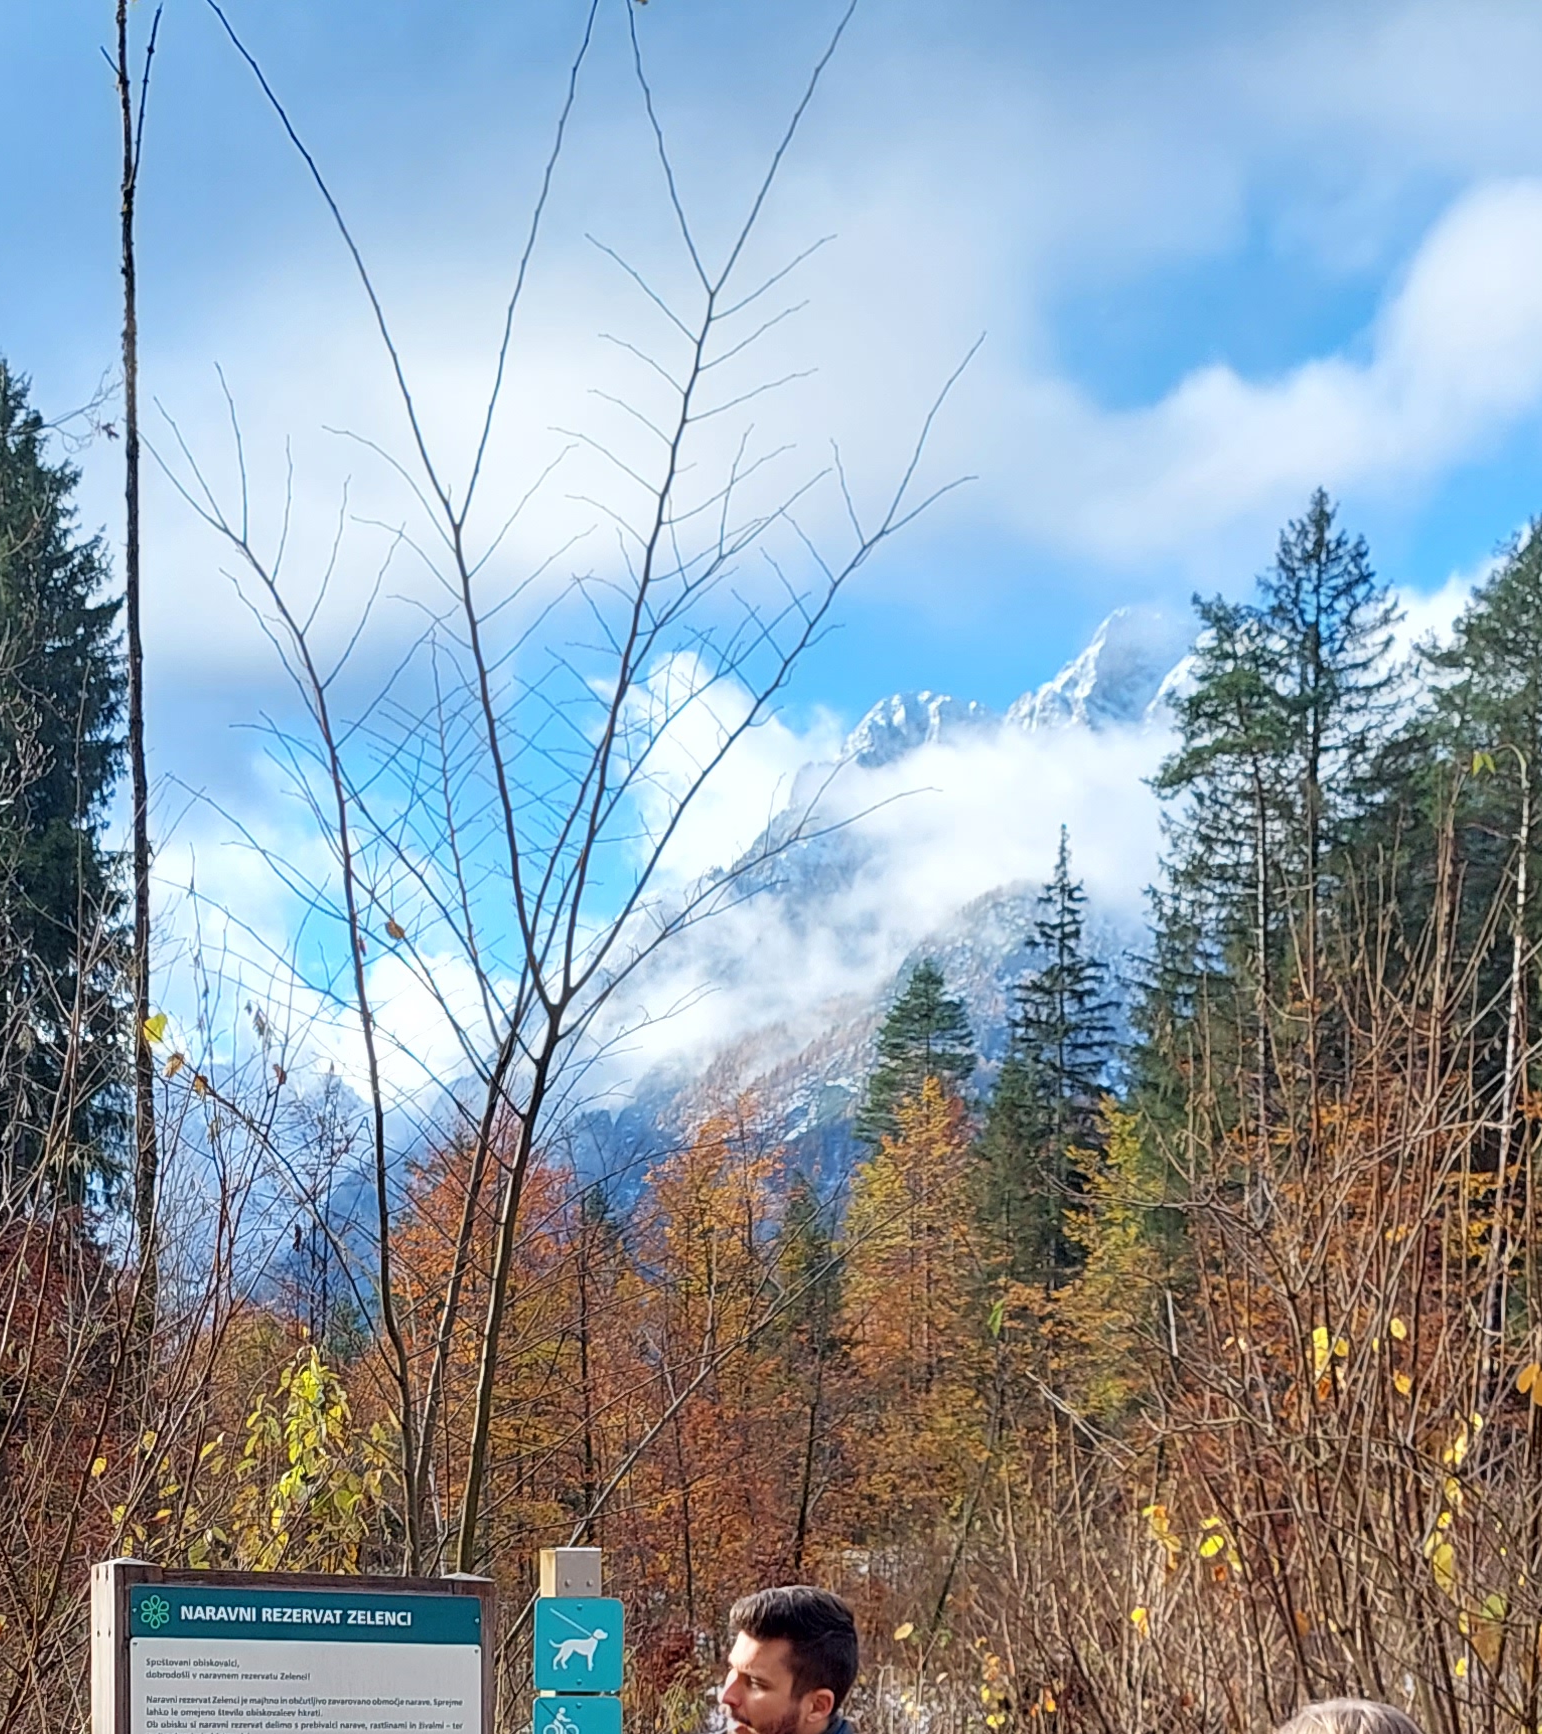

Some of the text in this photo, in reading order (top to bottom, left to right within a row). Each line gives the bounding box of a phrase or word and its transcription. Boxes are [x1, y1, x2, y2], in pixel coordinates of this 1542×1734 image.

[181, 1606, 411, 1625] NARAVNI REZERVAT ZELENCI
